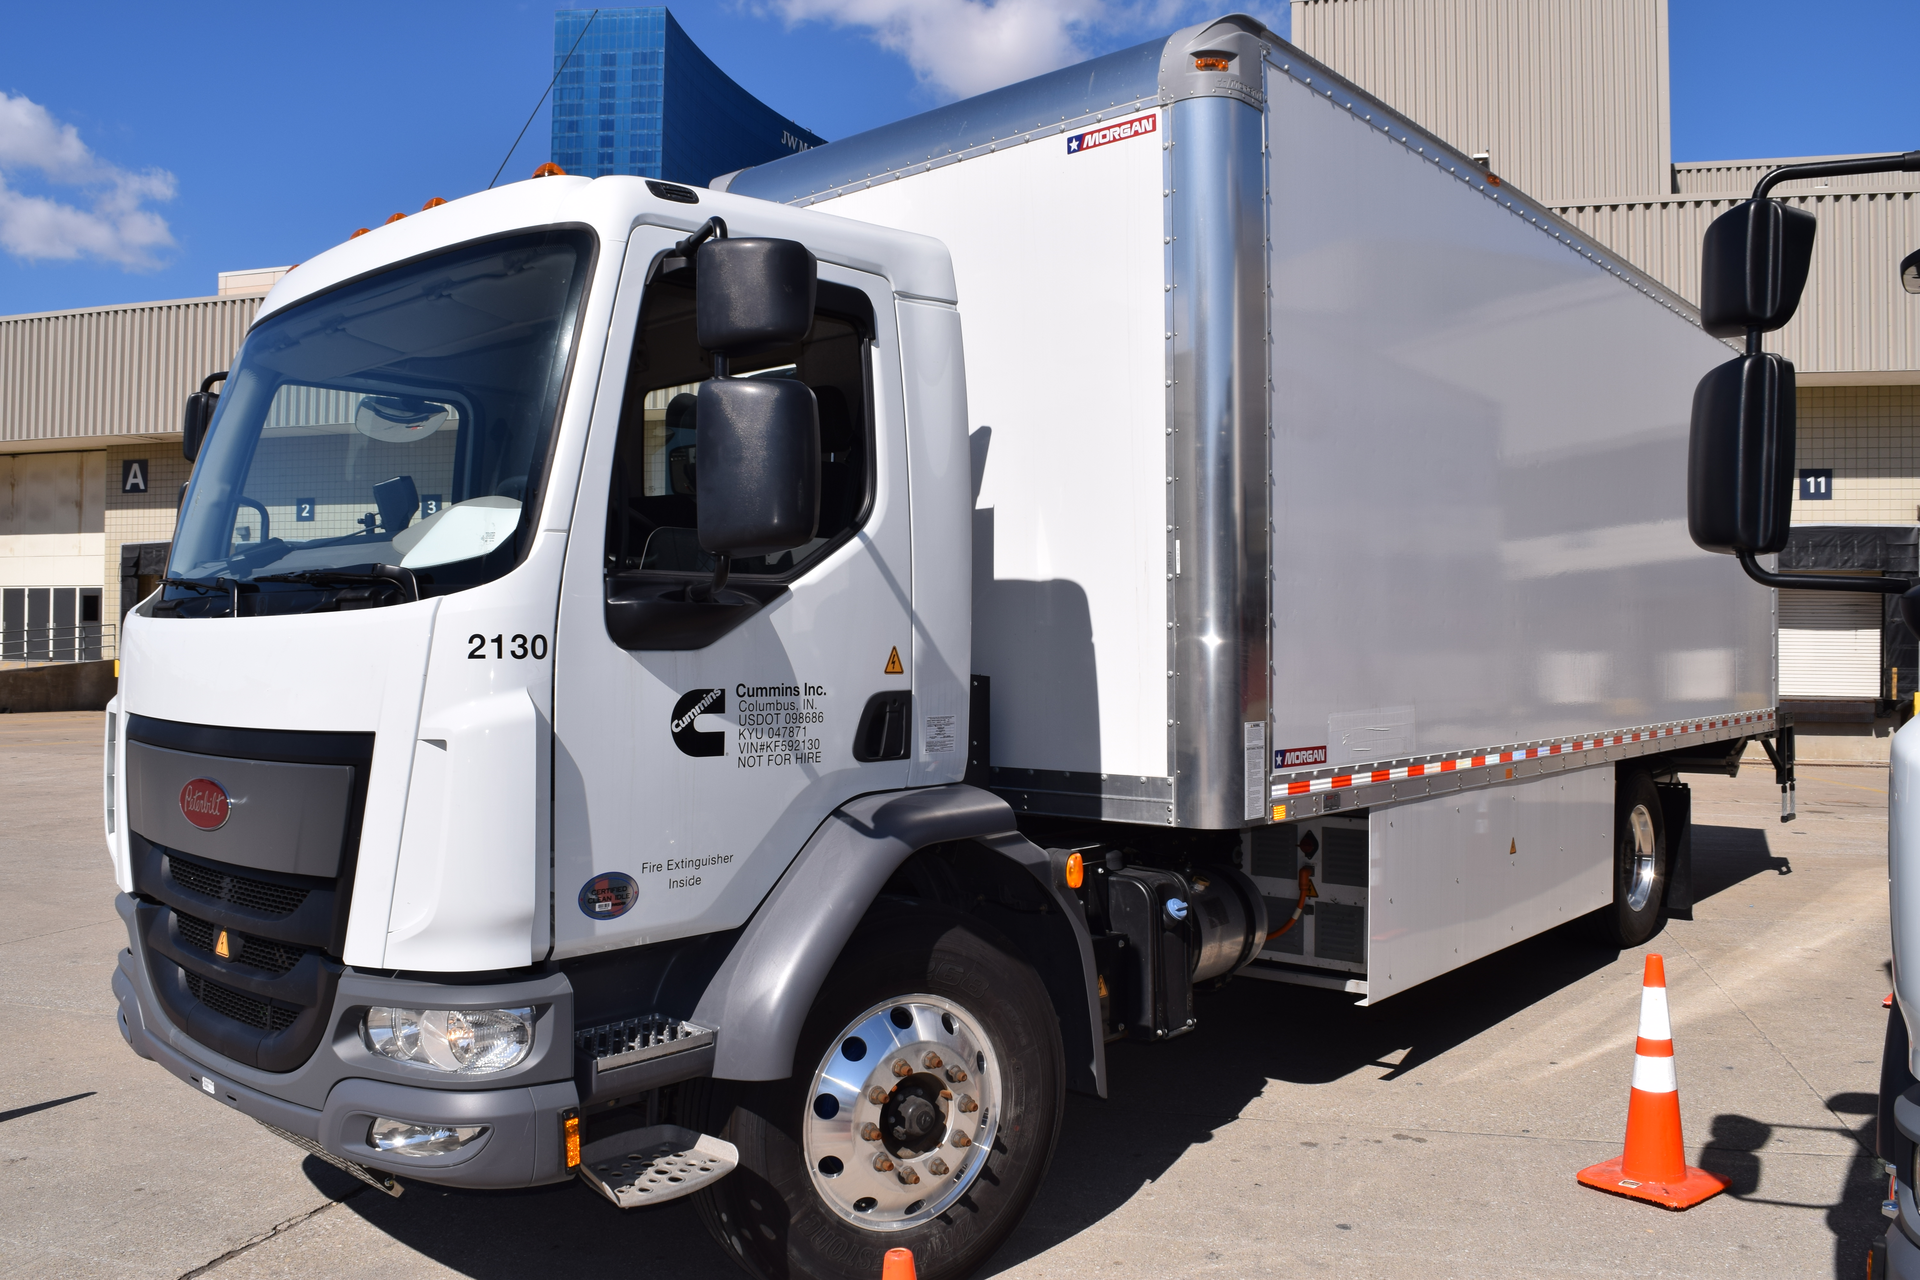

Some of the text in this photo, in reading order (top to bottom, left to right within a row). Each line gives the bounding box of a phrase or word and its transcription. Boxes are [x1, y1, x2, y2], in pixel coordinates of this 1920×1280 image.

[781, 130, 798, 150] JW
[1083, 117, 1153, 149] MORGAN
[125, 463, 145, 490] A
[1806, 476, 1826, 494] 11
[301, 504, 310, 517] 2
[427, 500, 437, 514] 3
[467, 633, 548, 660] 2130
[735, 682, 827, 698] Cummins Inc.
[671, 688, 722, 733] Cummins
[738, 698, 818, 713] Columbus, IN.
[738, 712, 824, 726] USDOT 098686
[738, 726, 807, 740] KYU 047871
[738, 739, 821, 754] VIN#KF592130
[738, 752, 821, 768] NOT FOR HIRE
[1284, 748, 1325, 765] MORGAN
[184, 785, 225, 815] Peterbilt
[641, 853, 734, 874] Fire Extinguisher
[668, 875, 702, 889] Inside
[587, 895, 612, 904] CLEAN
[615, 892, 631, 901] IDLE
[591, 885, 628, 896] CERTIFIED
[800, 1213, 975, 1272] BRIDESTONE
